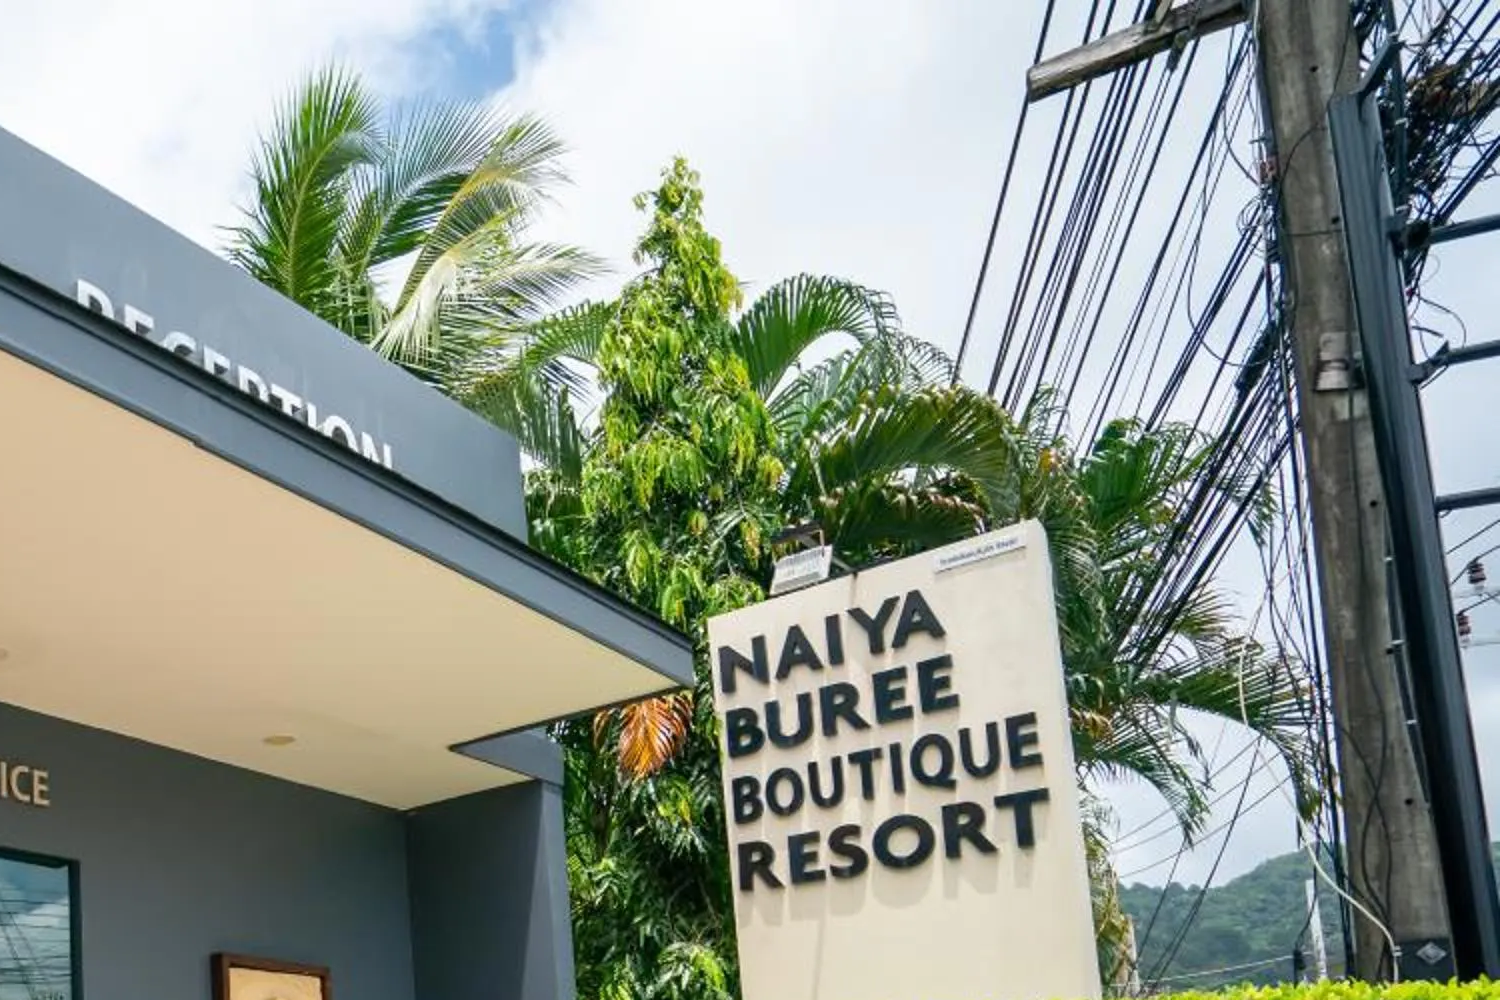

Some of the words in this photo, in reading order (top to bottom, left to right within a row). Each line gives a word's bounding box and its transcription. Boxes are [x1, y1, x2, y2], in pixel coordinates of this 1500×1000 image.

[717, 588, 947, 694] NAIYA
[725, 653, 960, 759] BUREE
[731, 711, 1044, 825] BOUTIQUE
[737, 787, 1051, 892] RESORT
